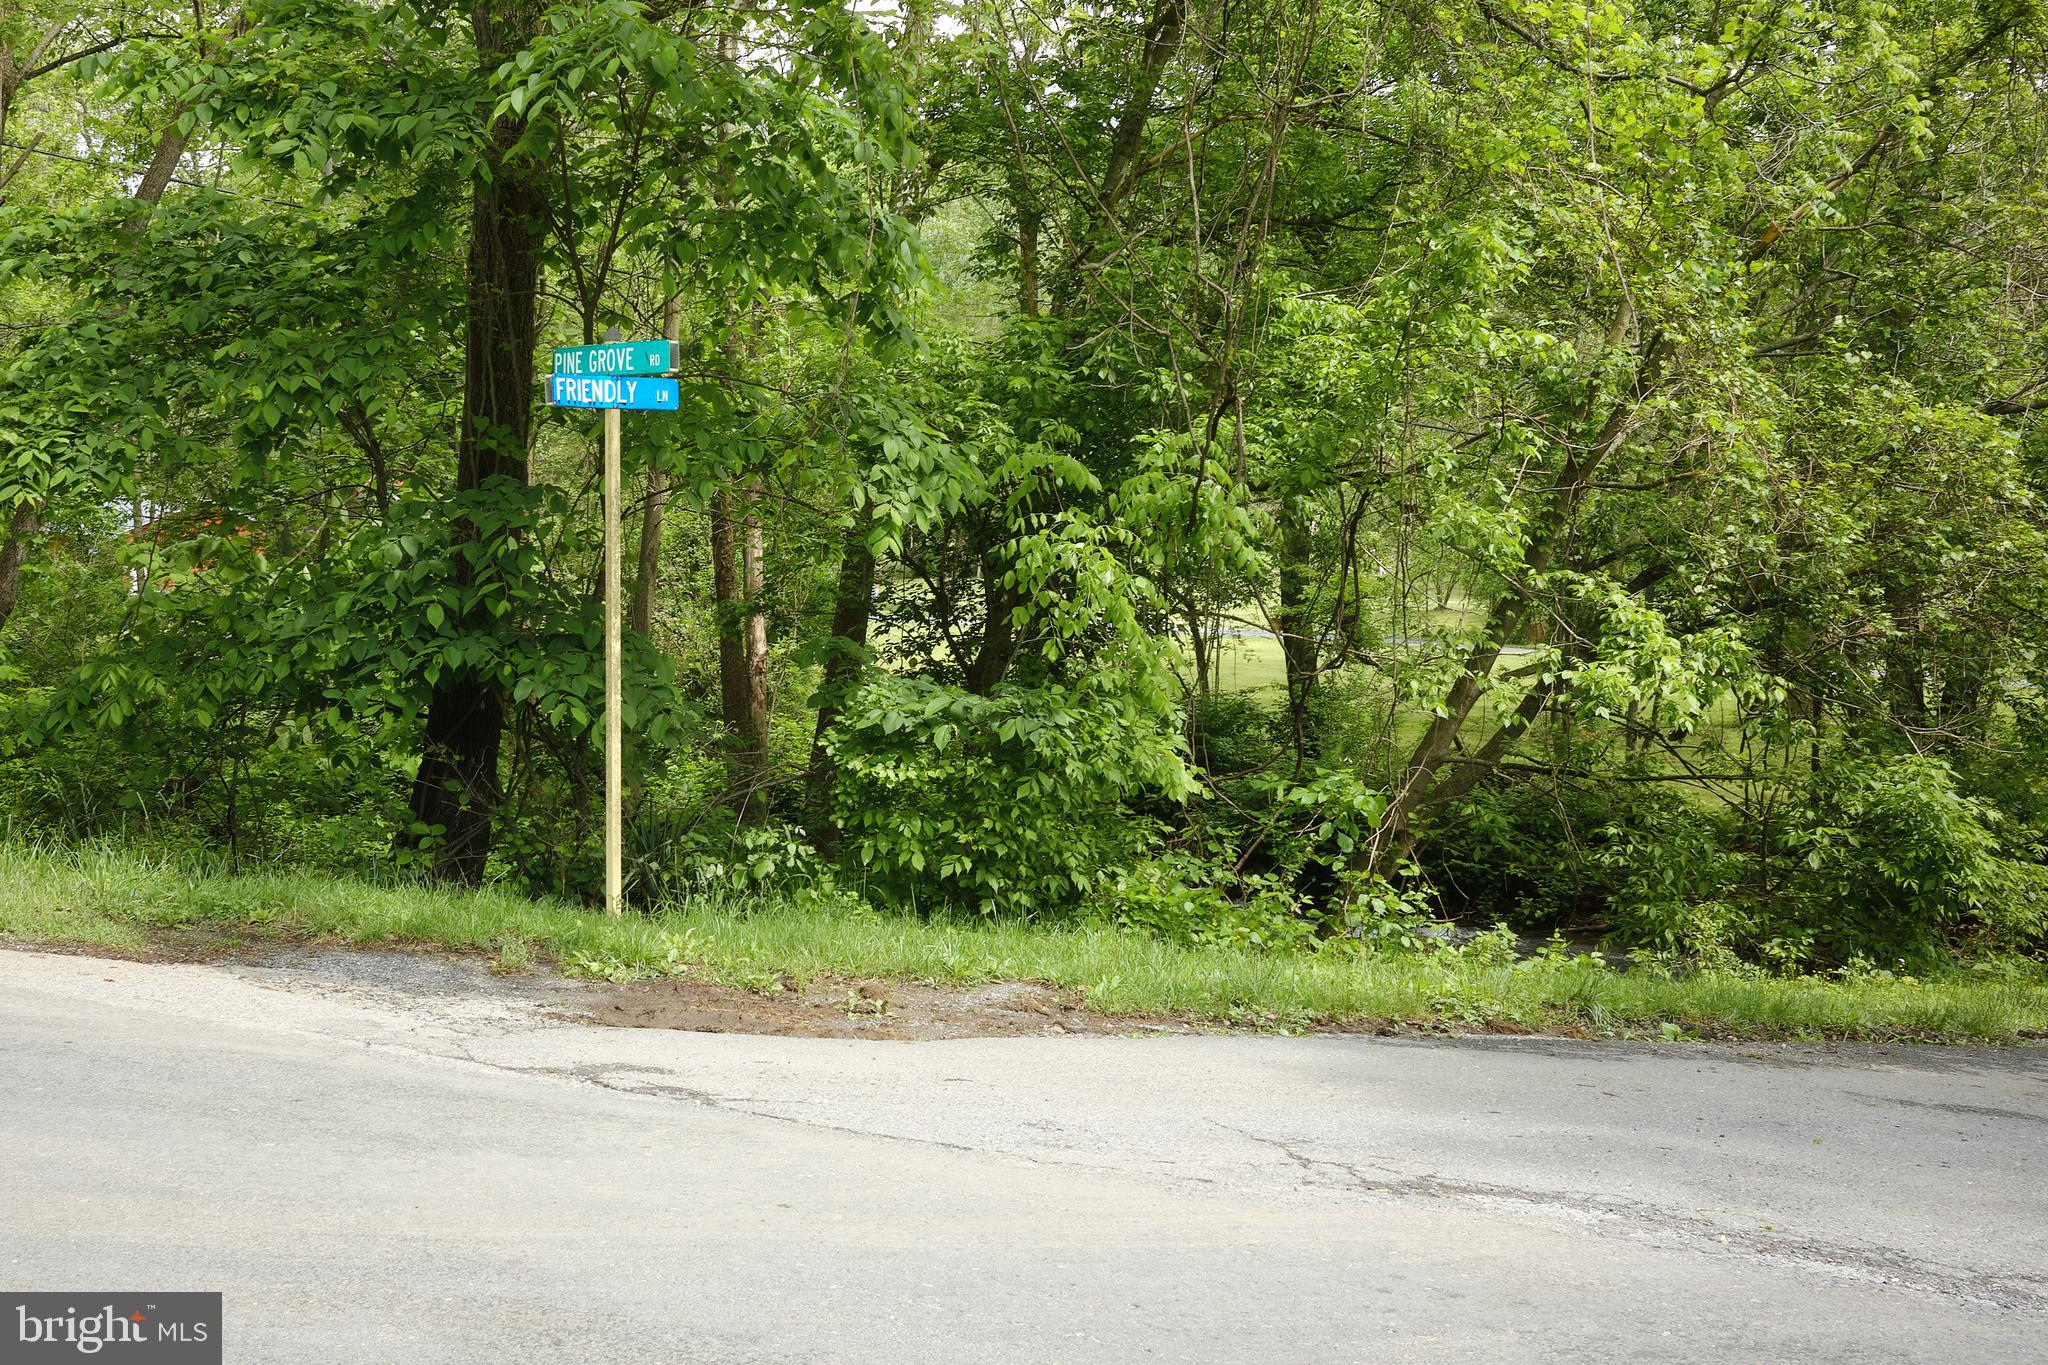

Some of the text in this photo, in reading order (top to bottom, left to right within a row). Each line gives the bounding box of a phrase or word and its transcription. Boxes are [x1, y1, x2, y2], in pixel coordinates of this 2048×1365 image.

[555, 347, 661, 374] PINE GROVE RD
[556, 377, 669, 404] FRIENDLY LN
